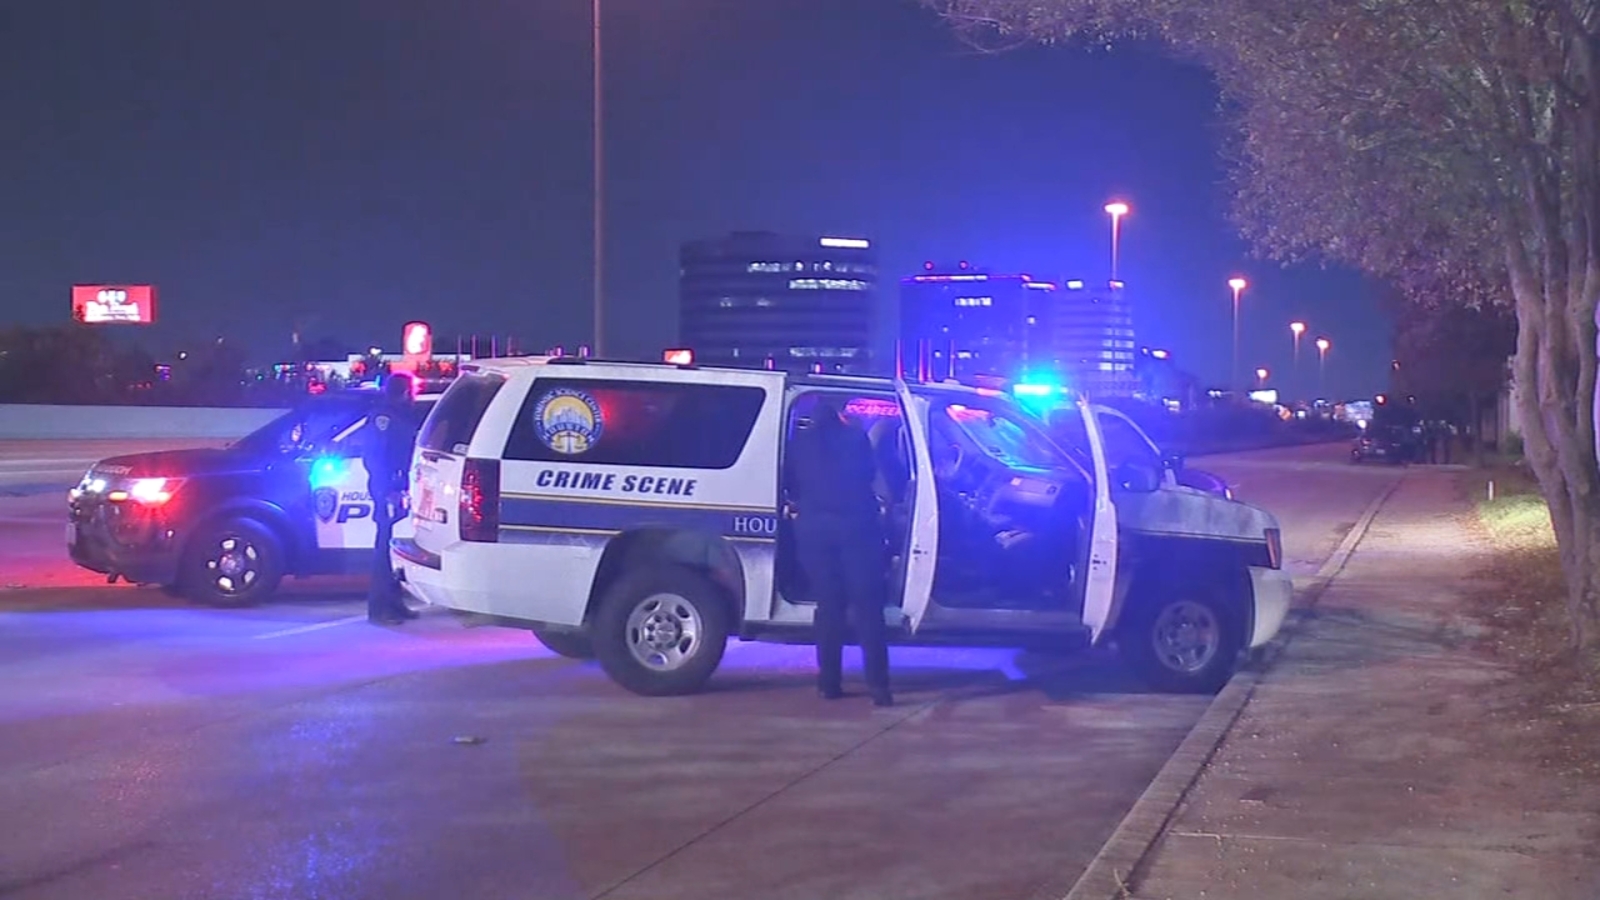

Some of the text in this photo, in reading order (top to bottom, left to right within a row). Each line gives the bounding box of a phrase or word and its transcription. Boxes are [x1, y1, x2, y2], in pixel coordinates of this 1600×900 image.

[536, 469, 697, 496] CRIME SCENE
[337, 504, 371, 523] P
[734, 517, 777, 534] HOU
